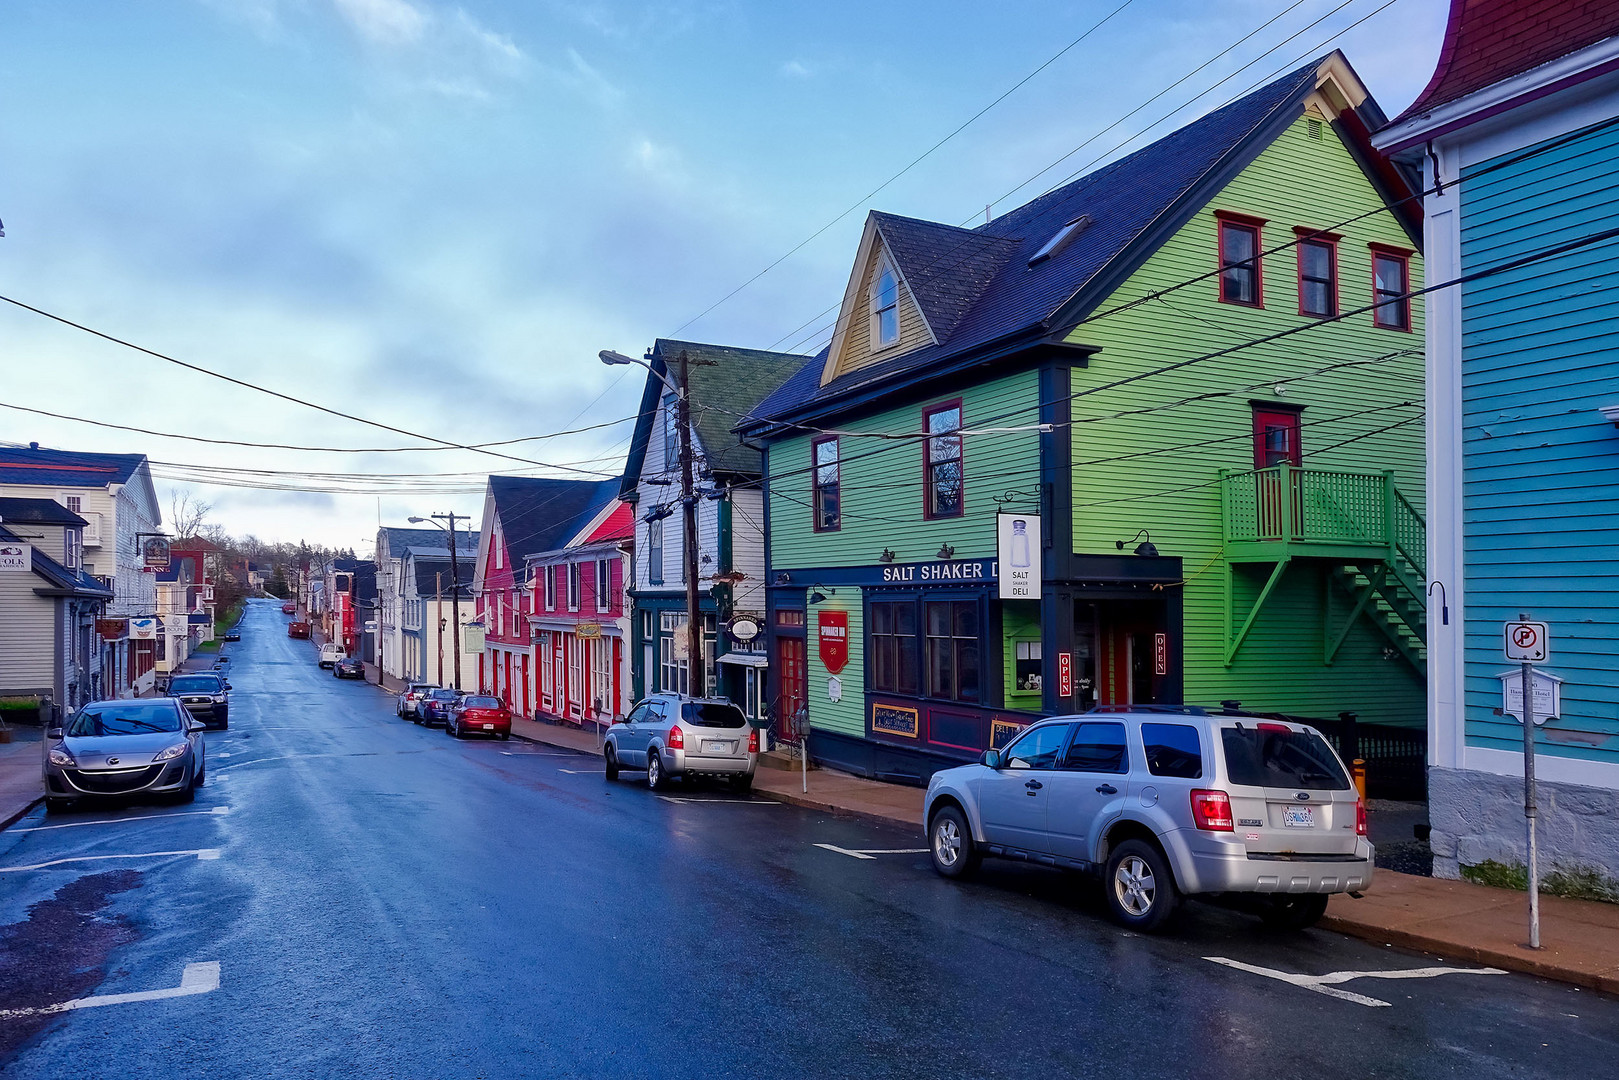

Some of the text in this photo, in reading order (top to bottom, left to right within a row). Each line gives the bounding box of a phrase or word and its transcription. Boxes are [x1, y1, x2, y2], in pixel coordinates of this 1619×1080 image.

[883, 566, 916, 581] SALT
[921, 562, 983, 580] SHAKER
[1012, 571, 1029, 579] SALT
[1012, 588, 1029, 596] DELI
[1061, 656, 1069, 693] OPEN
